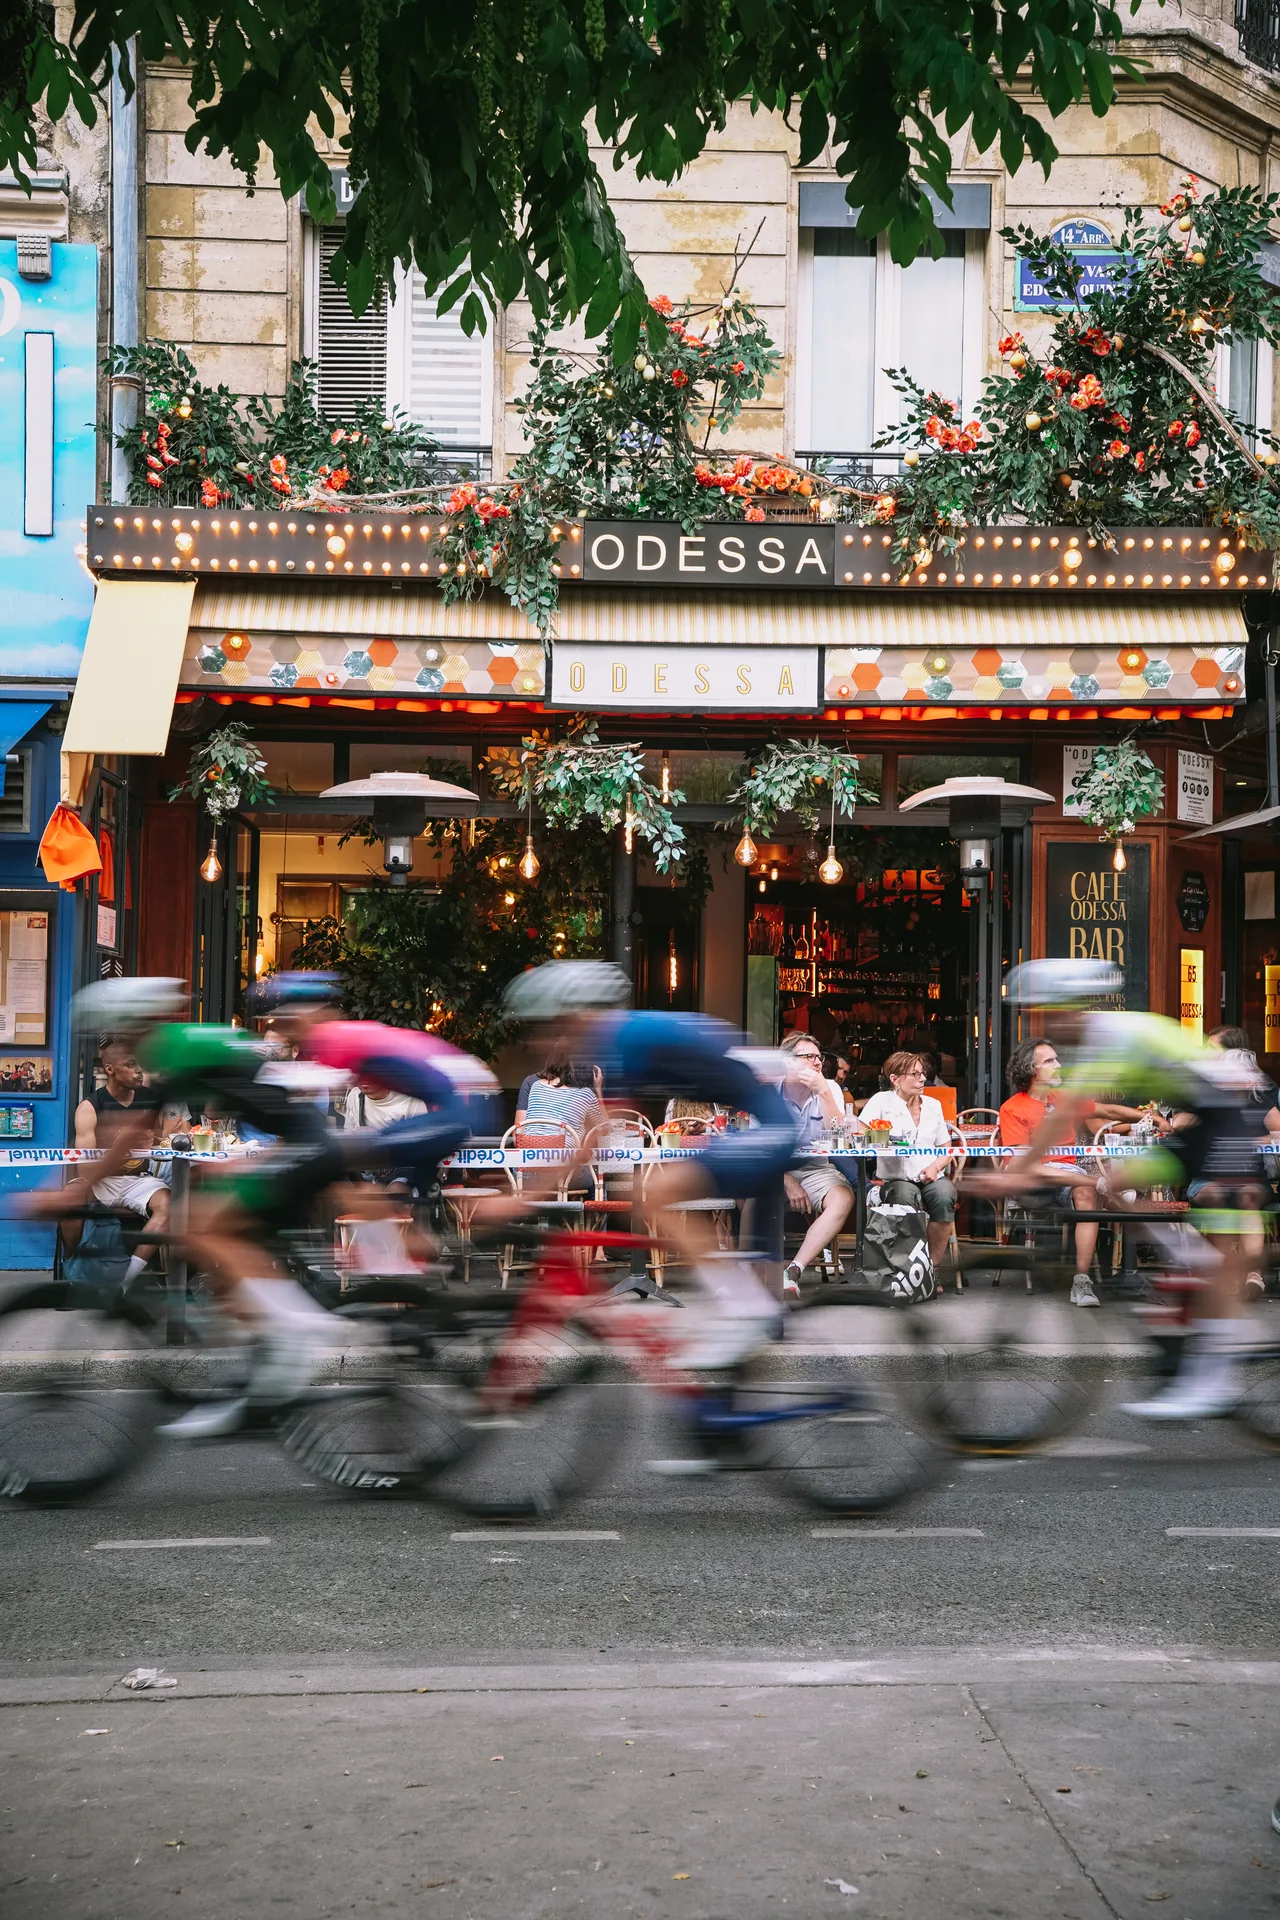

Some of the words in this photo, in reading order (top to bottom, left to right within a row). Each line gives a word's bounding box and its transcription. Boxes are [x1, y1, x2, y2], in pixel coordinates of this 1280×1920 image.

[591, 534, 827, 575] ODESSA
[570, 661, 794, 695] ODESSA
[1070, 901, 1127, 921] ODESSA
[1070, 927, 1126, 966] BAR
[1187, 965, 1196, 982] 65
[1104, 992, 1126, 1003] JOURS
[1180, 1003, 1202, 1018] ODESSA
[9, 1149, 64, 1163] Mutuel
[457, 1149, 505, 1164] Crédit
[523, 1149, 574, 1162] Mutuel
[595, 1149, 643, 1162] Crédit
